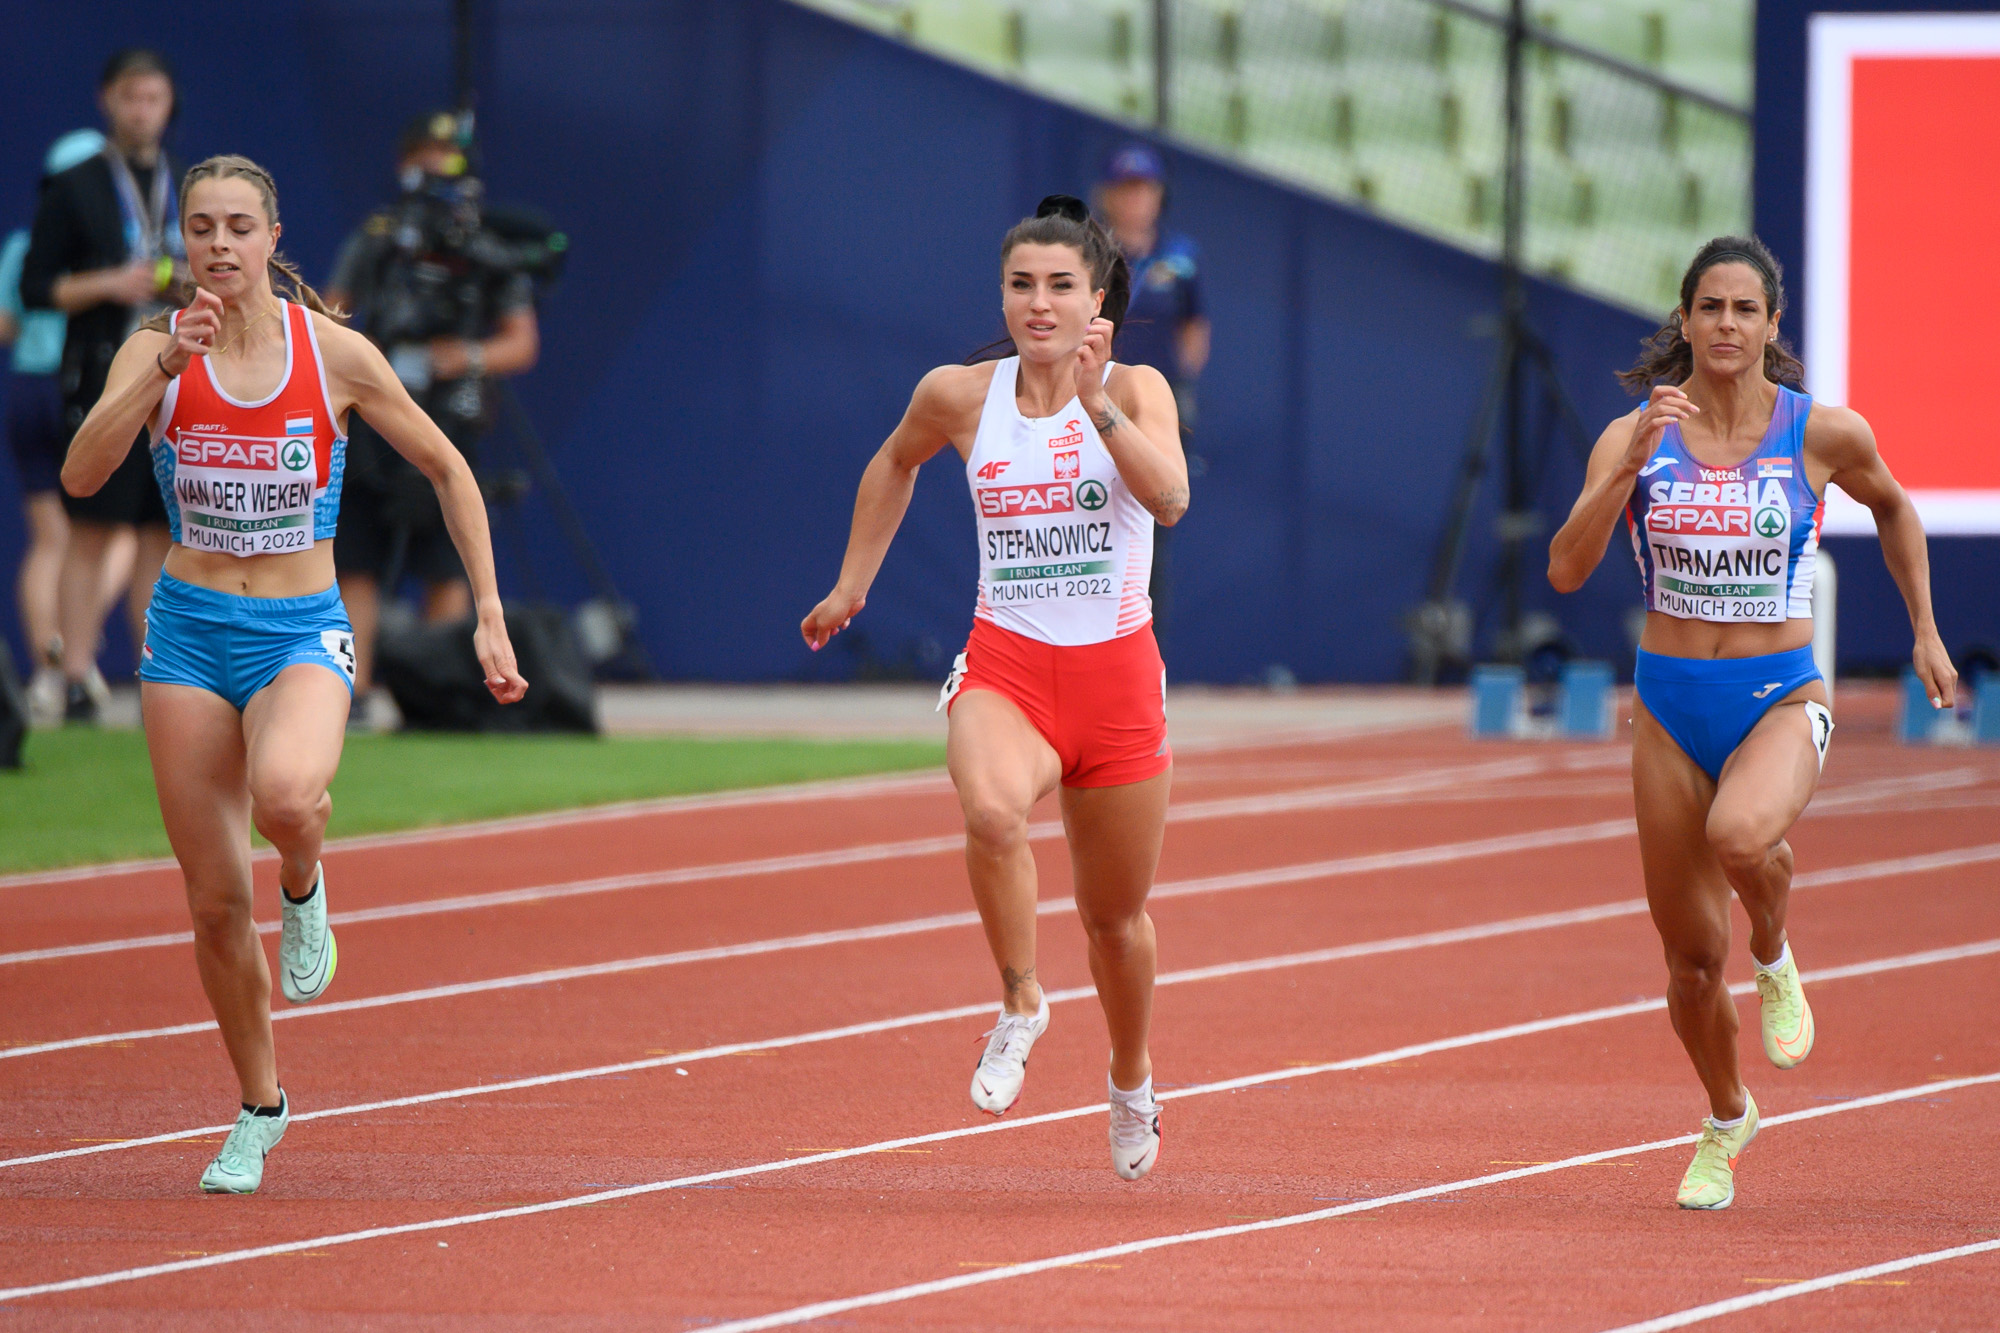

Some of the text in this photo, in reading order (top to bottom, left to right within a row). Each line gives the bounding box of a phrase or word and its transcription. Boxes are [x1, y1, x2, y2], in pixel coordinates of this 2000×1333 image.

[192, 423, 221, 431] CRAFT
[1050, 434, 1082, 447] ORLEN
[180, 439, 275, 467] SPAR
[976, 461, 1011, 480] 4F
[177, 477, 312, 513] VAN DER WEKEN
[980, 486, 1071, 514] SPAR
[1649, 478, 1790, 505] SERBIA
[214, 517, 238, 530] RUN
[1651, 508, 1748, 532] SPAR
[189, 527, 306, 552] MUNICH 2022
[987, 521, 1113, 561] STEFANOWICZ
[1652, 543, 1783, 578] TIRNANIC
[1016, 567, 1041, 579] RUN
[992, 578, 1112, 601] MUNICH 2022
[1683, 583, 1708, 595] RUN
[1660, 592, 1777, 617] MUNICH 2022
